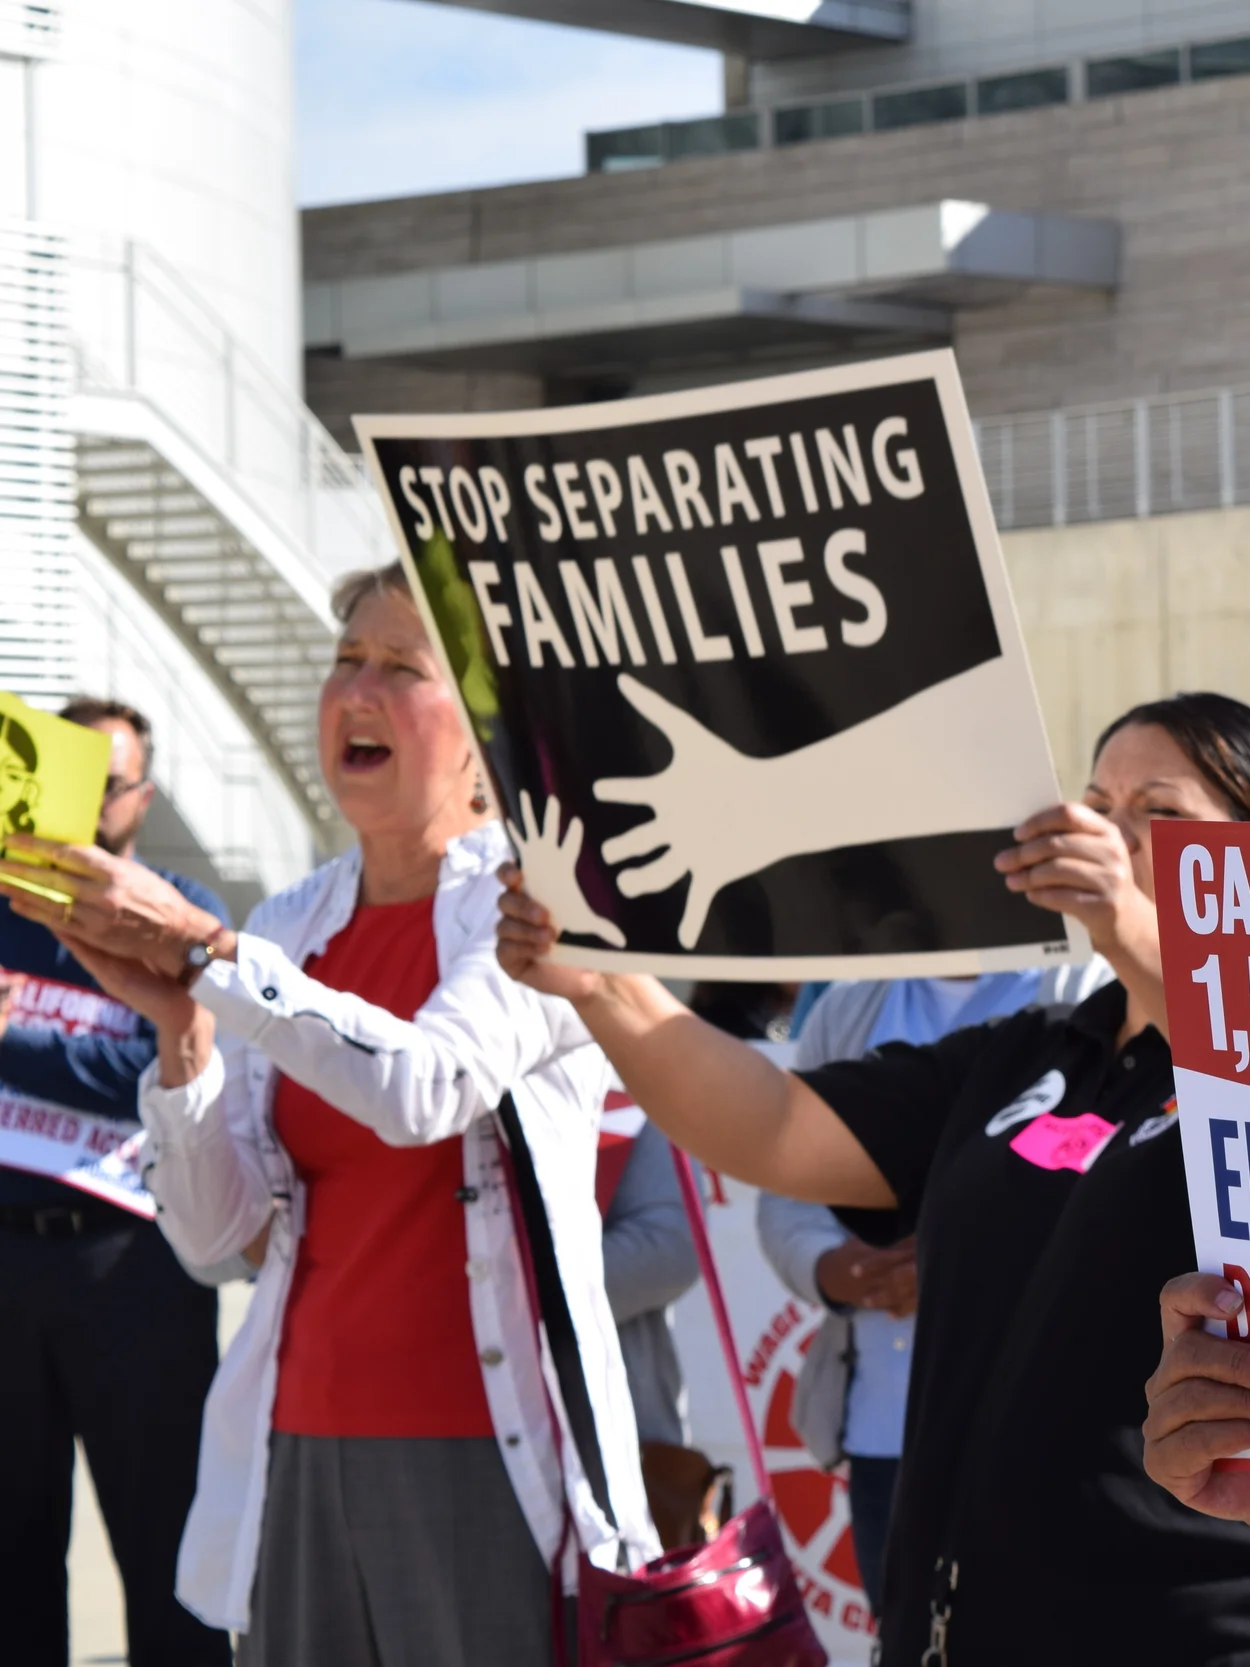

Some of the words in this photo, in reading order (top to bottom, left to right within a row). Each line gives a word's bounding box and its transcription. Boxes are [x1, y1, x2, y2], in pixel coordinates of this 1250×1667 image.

[398, 465, 512, 543] STOP
[523, 416, 925, 543] SEPARATING
[467, 528, 888, 668] FAMILIES
